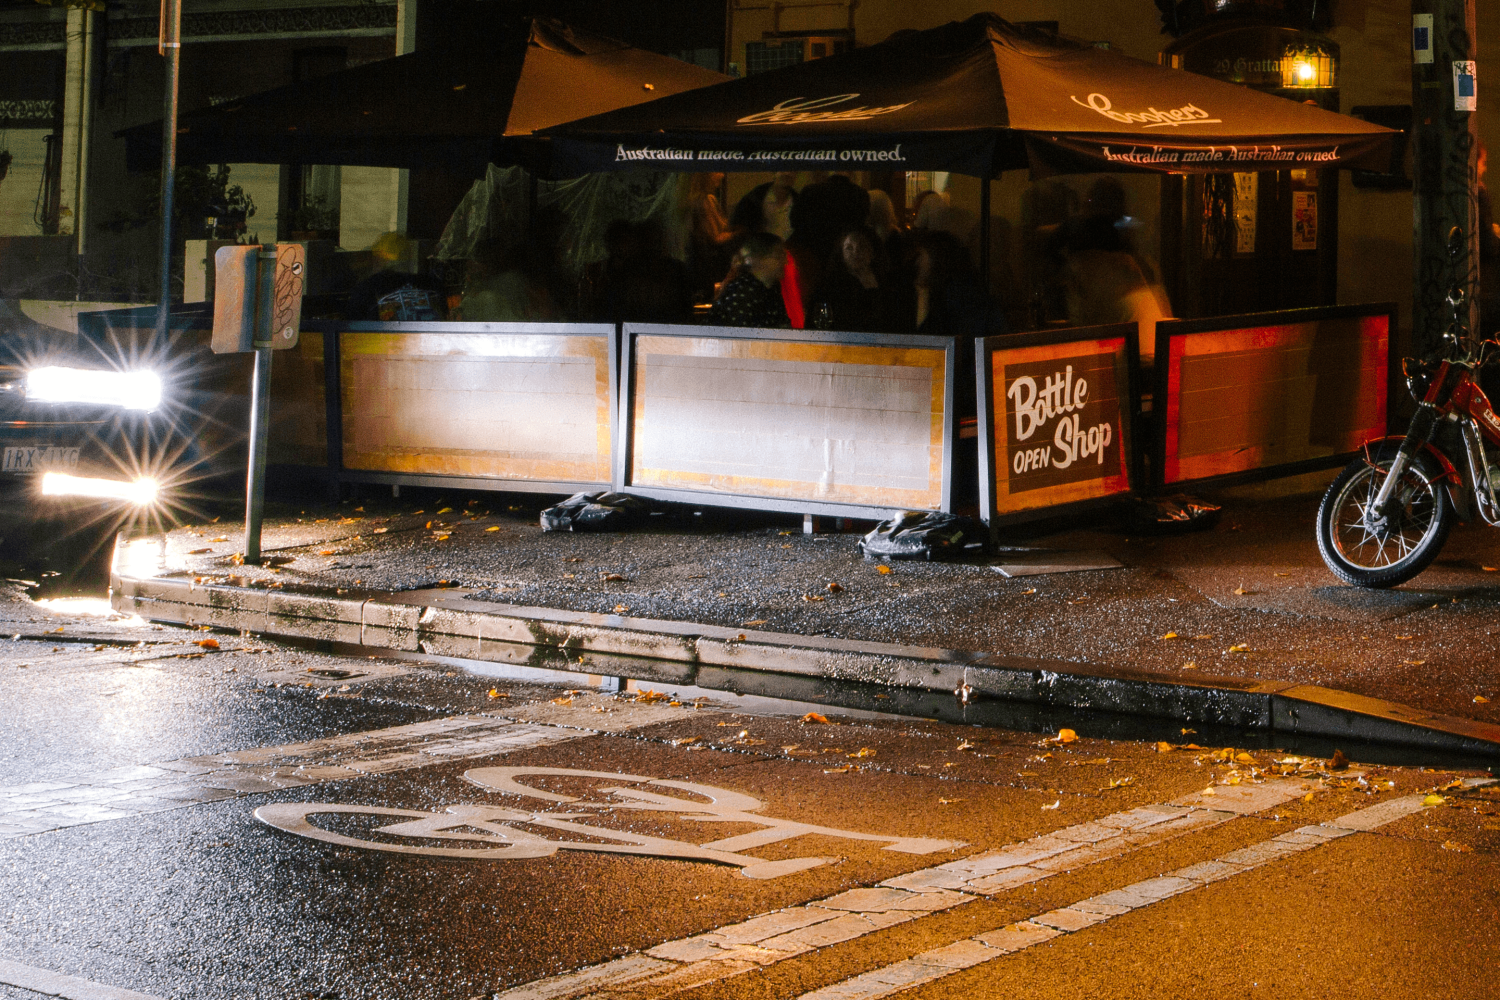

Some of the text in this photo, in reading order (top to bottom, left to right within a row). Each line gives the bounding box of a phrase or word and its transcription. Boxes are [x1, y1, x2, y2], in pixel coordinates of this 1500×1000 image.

[1233, 56, 1285, 73] Gratta
[1071, 92, 1223, 128] Coopers
[615, 143, 694, 162] Australian
[840, 143, 907, 162] owned.
[1102, 145, 1341, 163] Australian made. Australian owned.
[1007, 365, 1089, 441] Bottle
[1013, 413, 1112, 474] OPEN Shop
